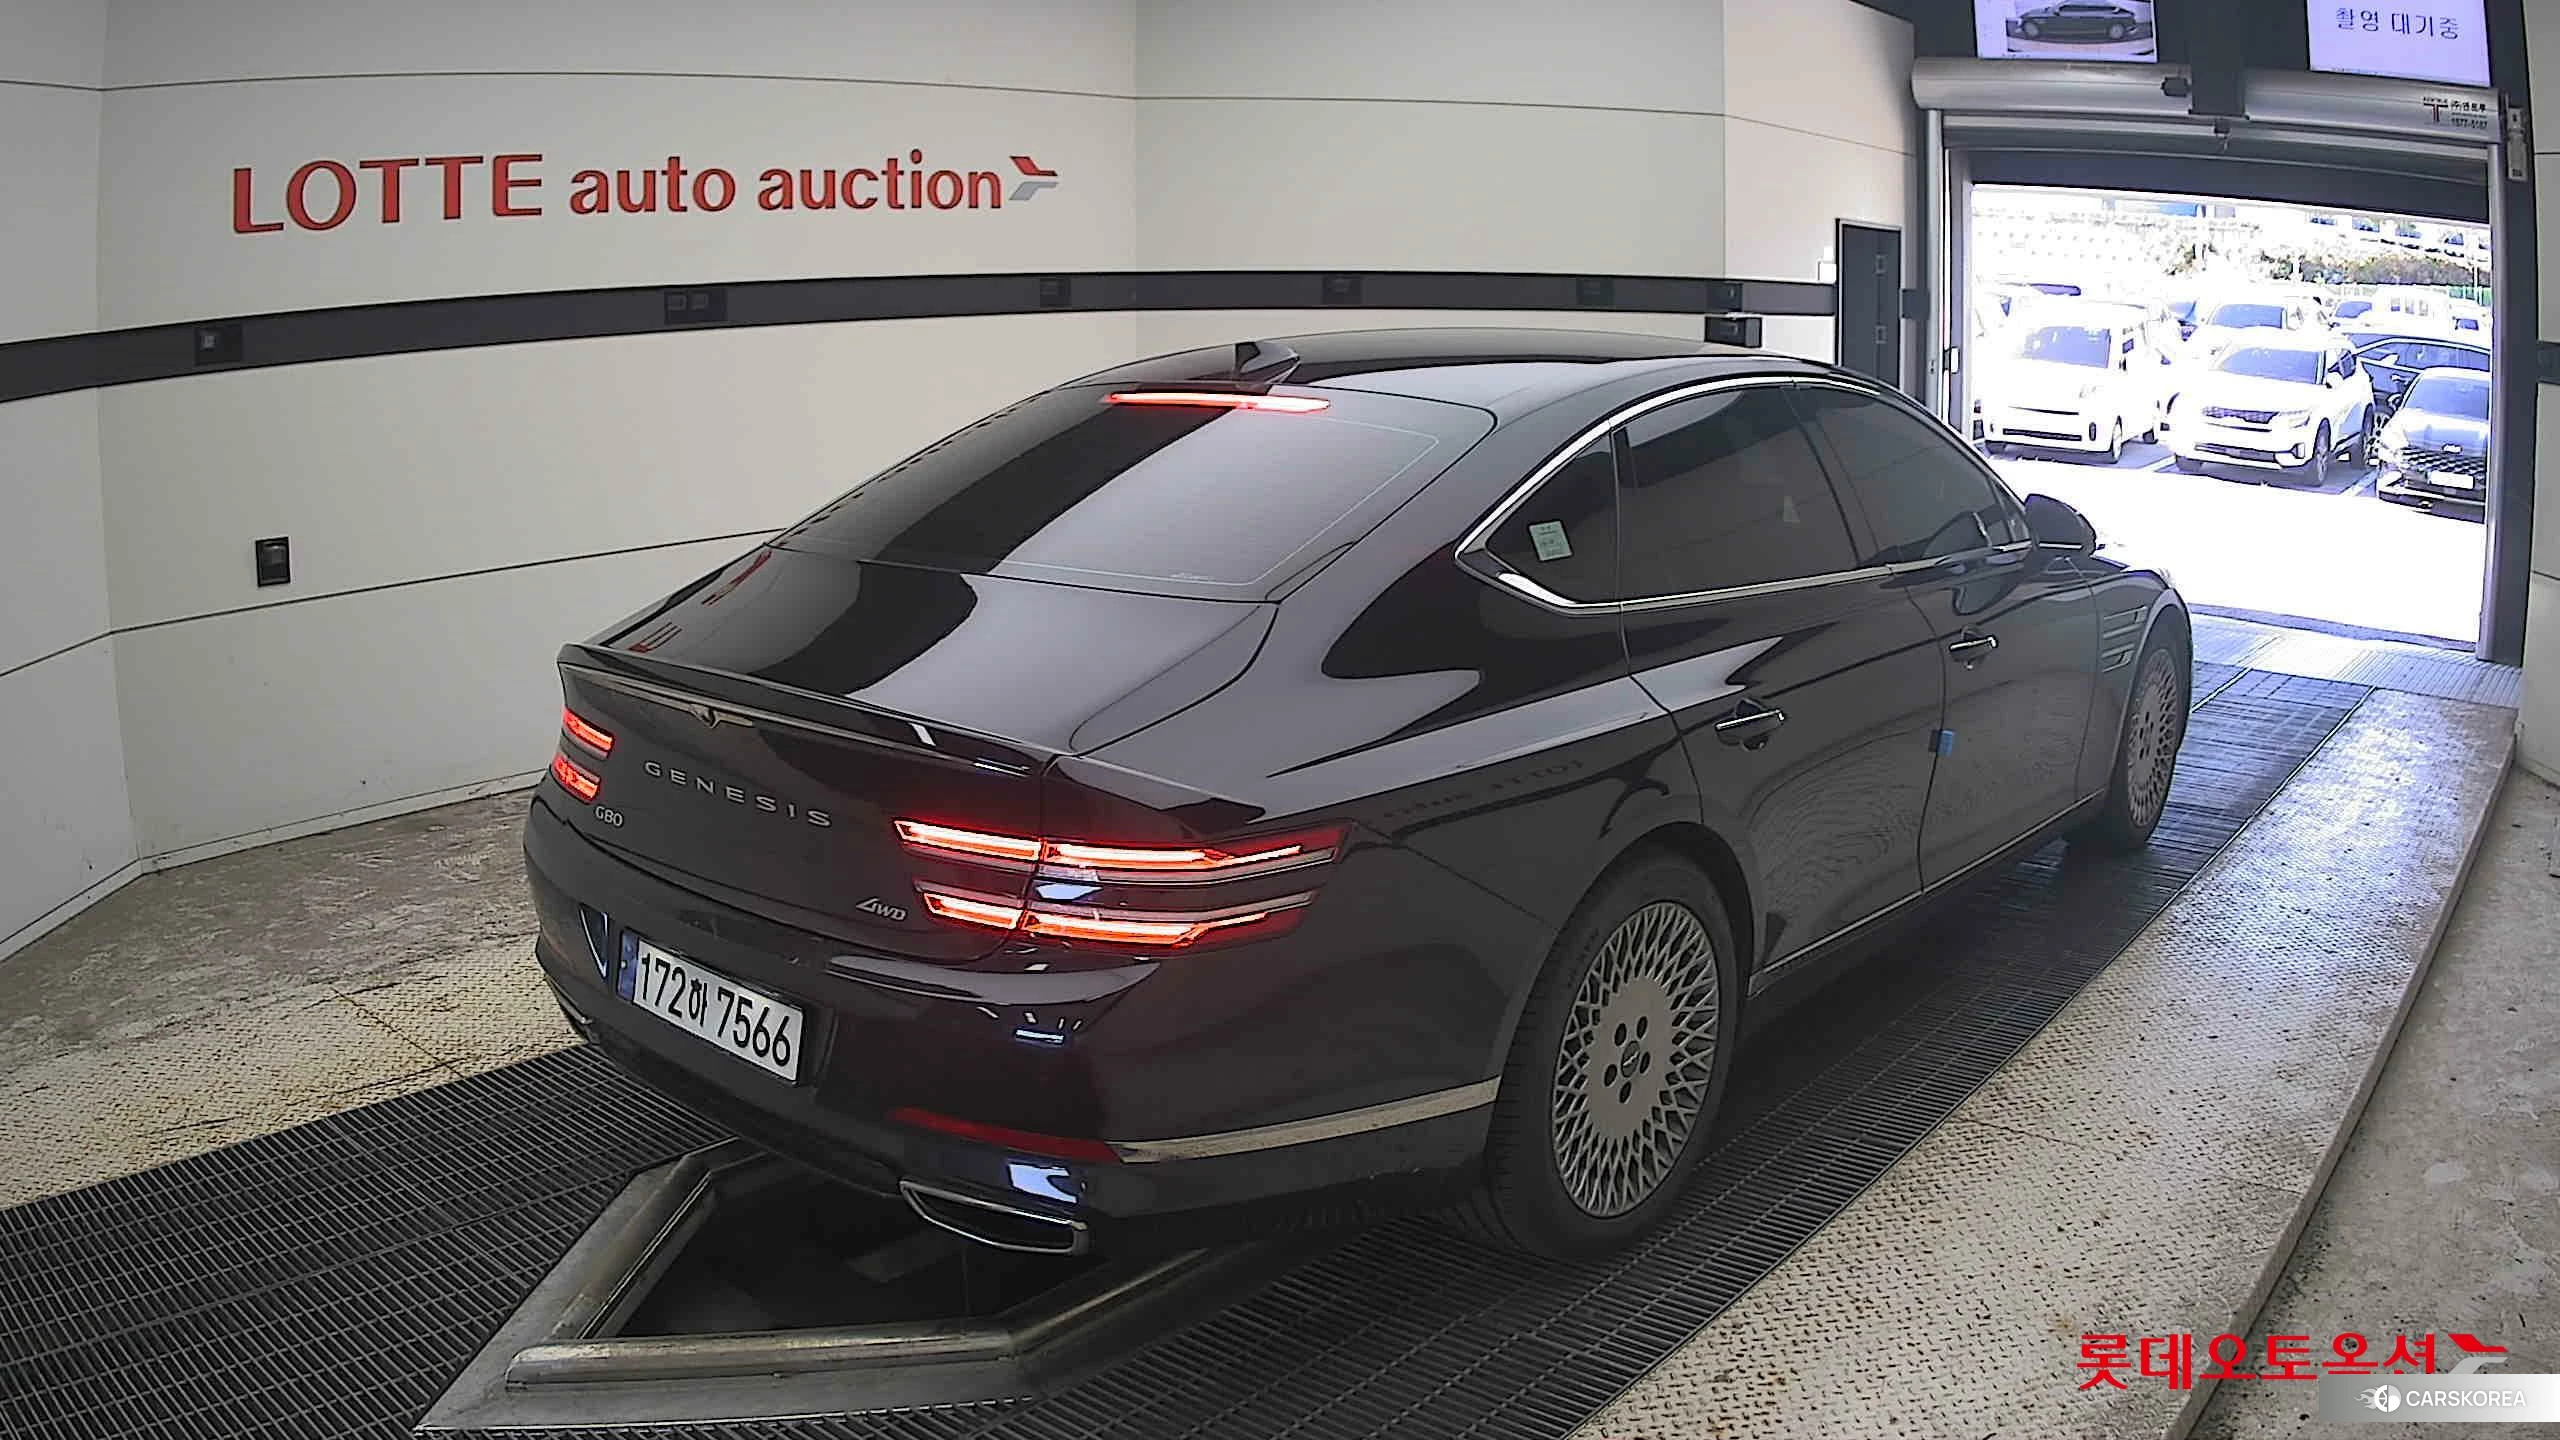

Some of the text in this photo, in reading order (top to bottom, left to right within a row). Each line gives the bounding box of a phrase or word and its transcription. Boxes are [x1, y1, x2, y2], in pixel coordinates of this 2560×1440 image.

[2336, 8, 2458, 40] 촬영 대기중
[233, 149, 1002, 234] LOTTE auto auction
[594, 805, 624, 828] G80
[644, 760, 832, 828] GENESIS
